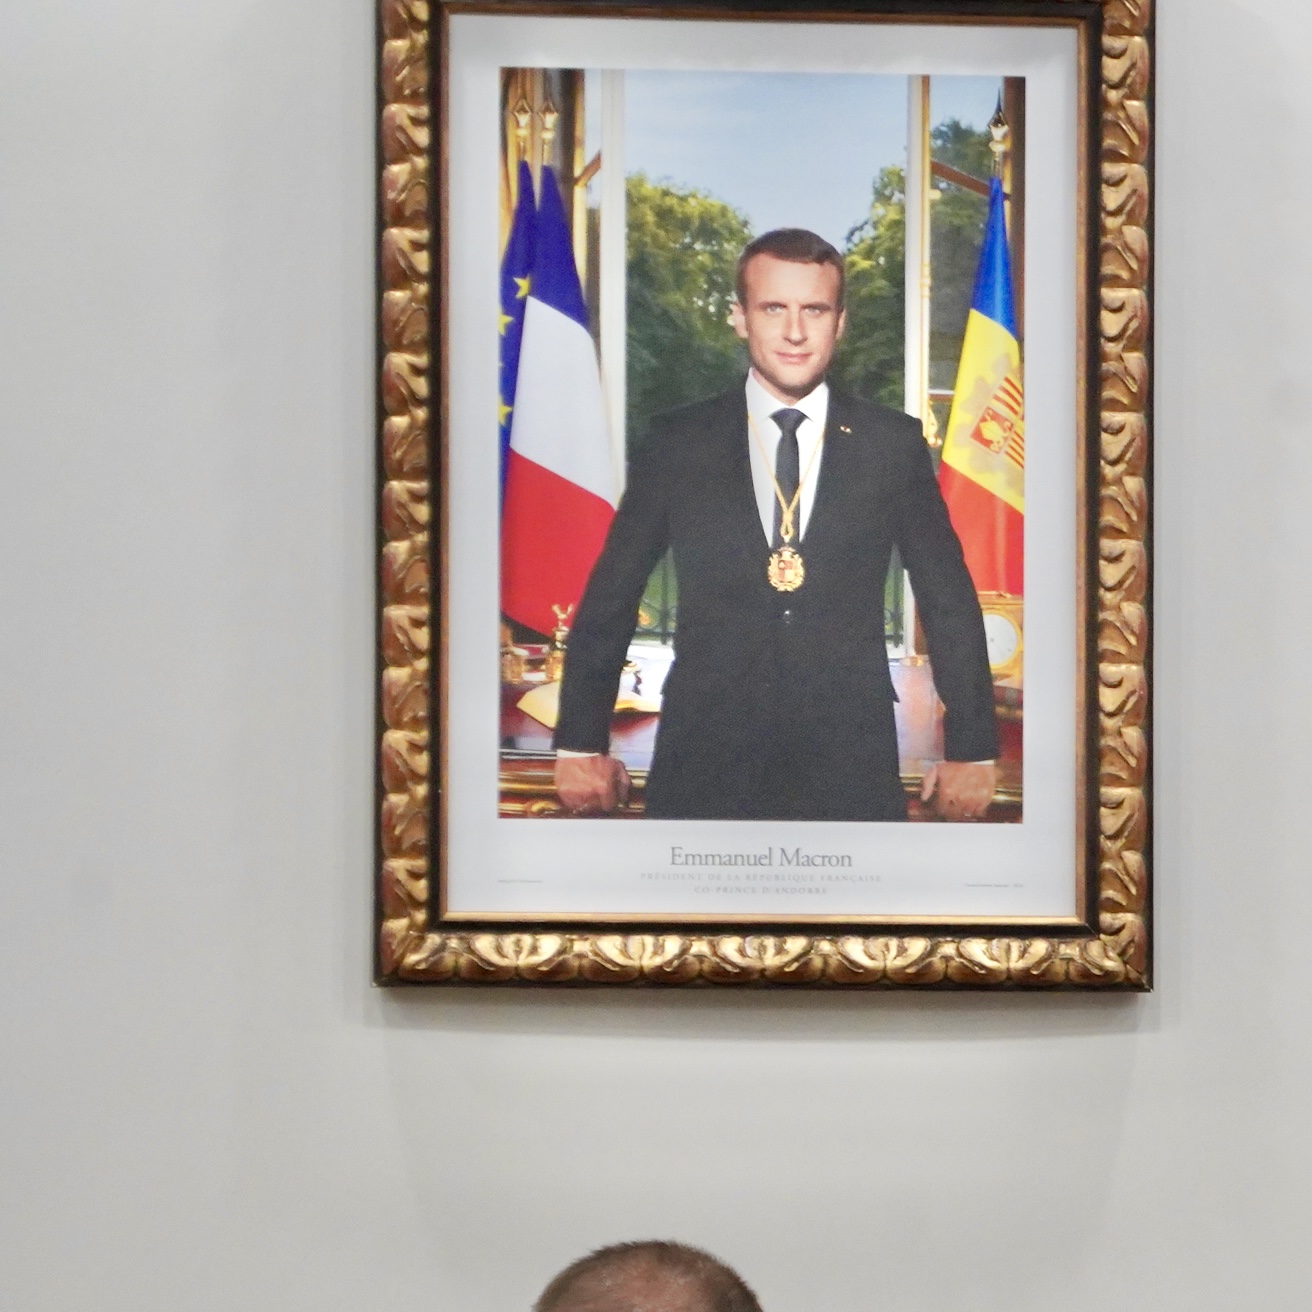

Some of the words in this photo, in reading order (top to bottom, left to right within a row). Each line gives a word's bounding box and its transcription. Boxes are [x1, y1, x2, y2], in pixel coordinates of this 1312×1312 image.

[669, 846, 773, 867] Emmanuel
[778, 847, 854, 868] Macron
[707, 872, 722, 881] DE
[727, 873, 741, 881] LA
